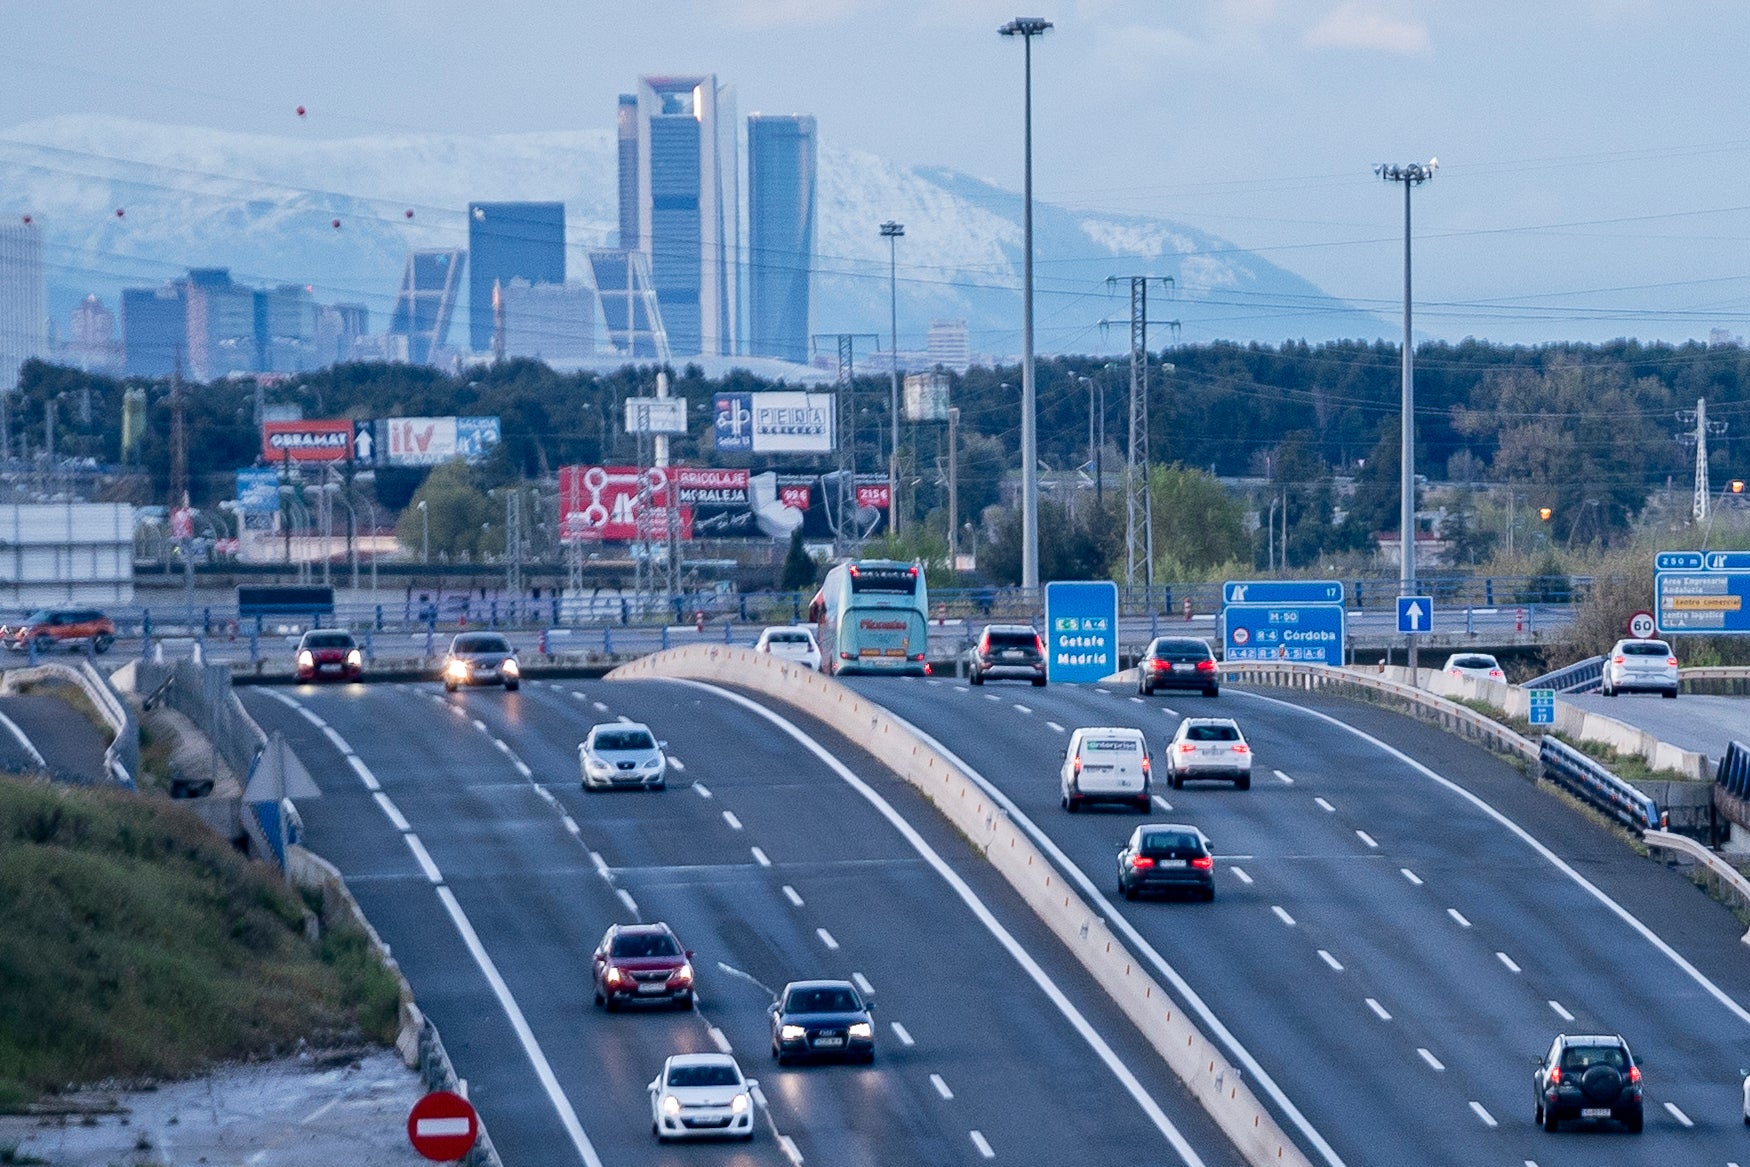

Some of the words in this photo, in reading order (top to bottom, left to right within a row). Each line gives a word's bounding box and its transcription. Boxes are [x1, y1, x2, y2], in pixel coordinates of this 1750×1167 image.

[270, 433, 347, 447] OBRAMAT
[680, 473, 746, 486] BRICOLAJE
[1326, 587, 1337, 597] 17
[1634, 620, 1652, 631] 60
[1059, 635, 1105, 647] Getafe
[1283, 629, 1336, 641] Córdoba
[1057, 653, 1107, 665] Madrid
